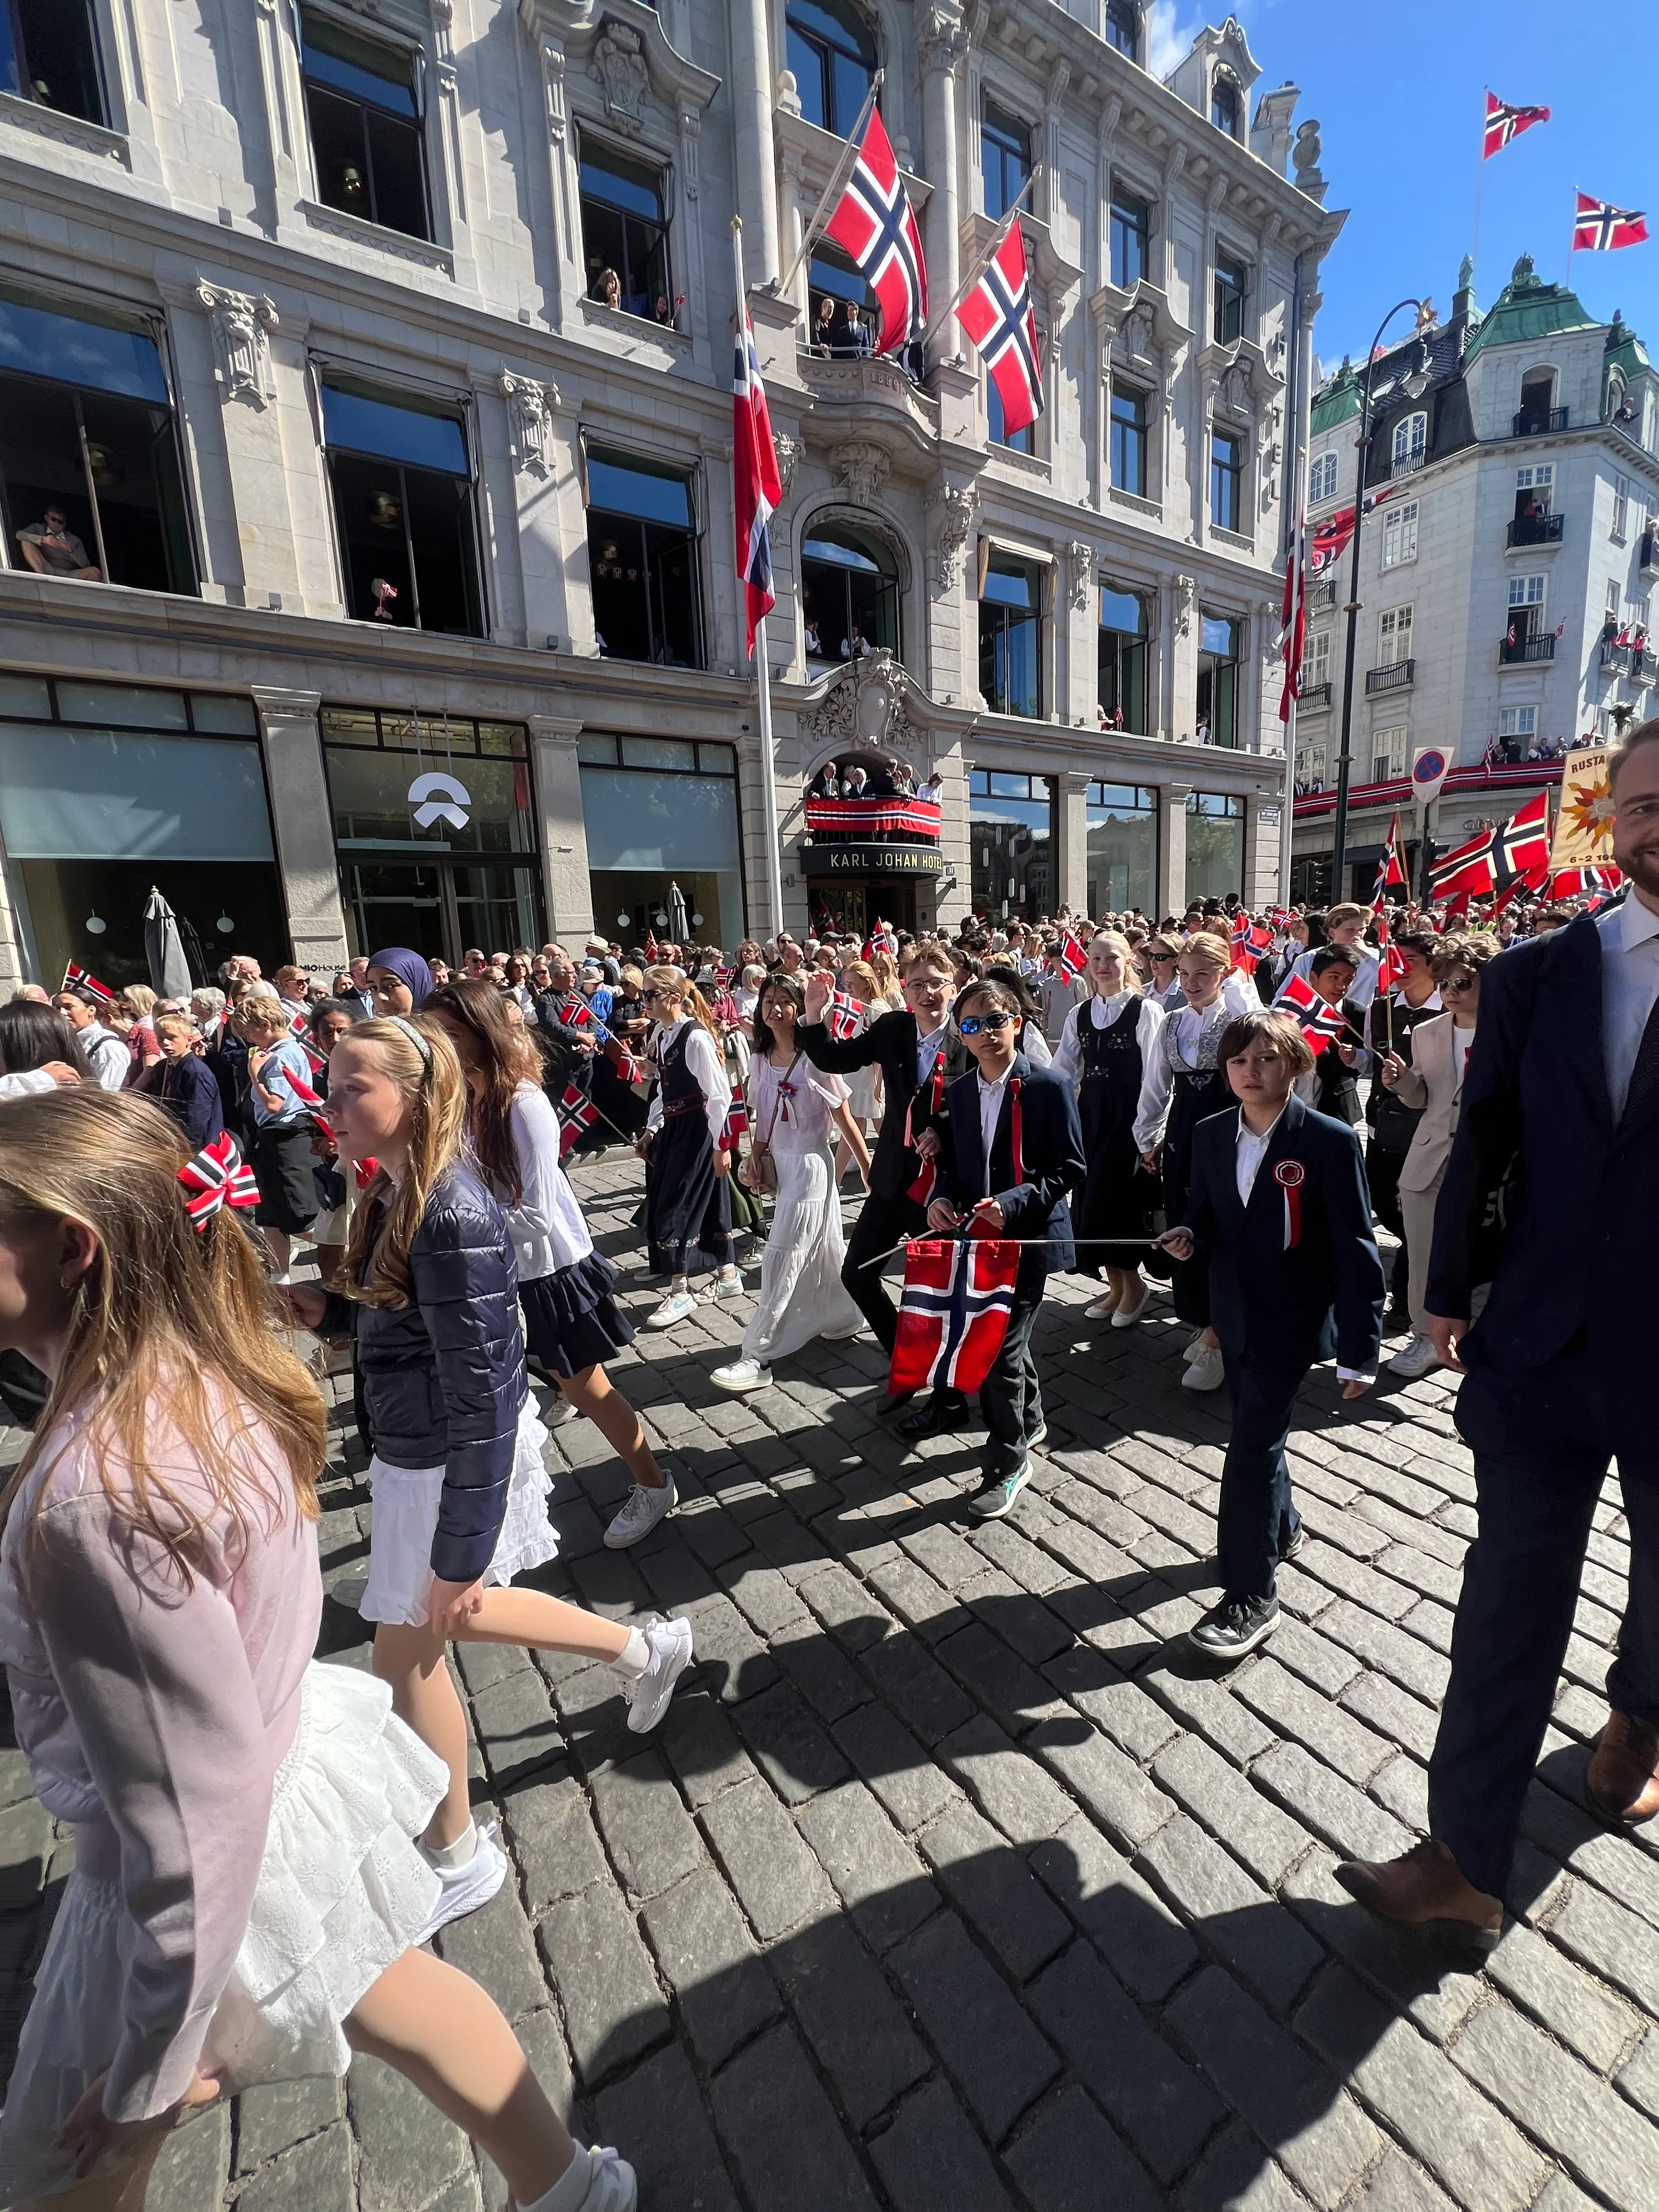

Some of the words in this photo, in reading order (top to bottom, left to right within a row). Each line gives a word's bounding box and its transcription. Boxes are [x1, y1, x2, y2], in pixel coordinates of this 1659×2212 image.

[831, 854, 869, 867] KARL
[876, 853, 918, 867] JOHAN
[922, 855, 943, 870] HOTEL
